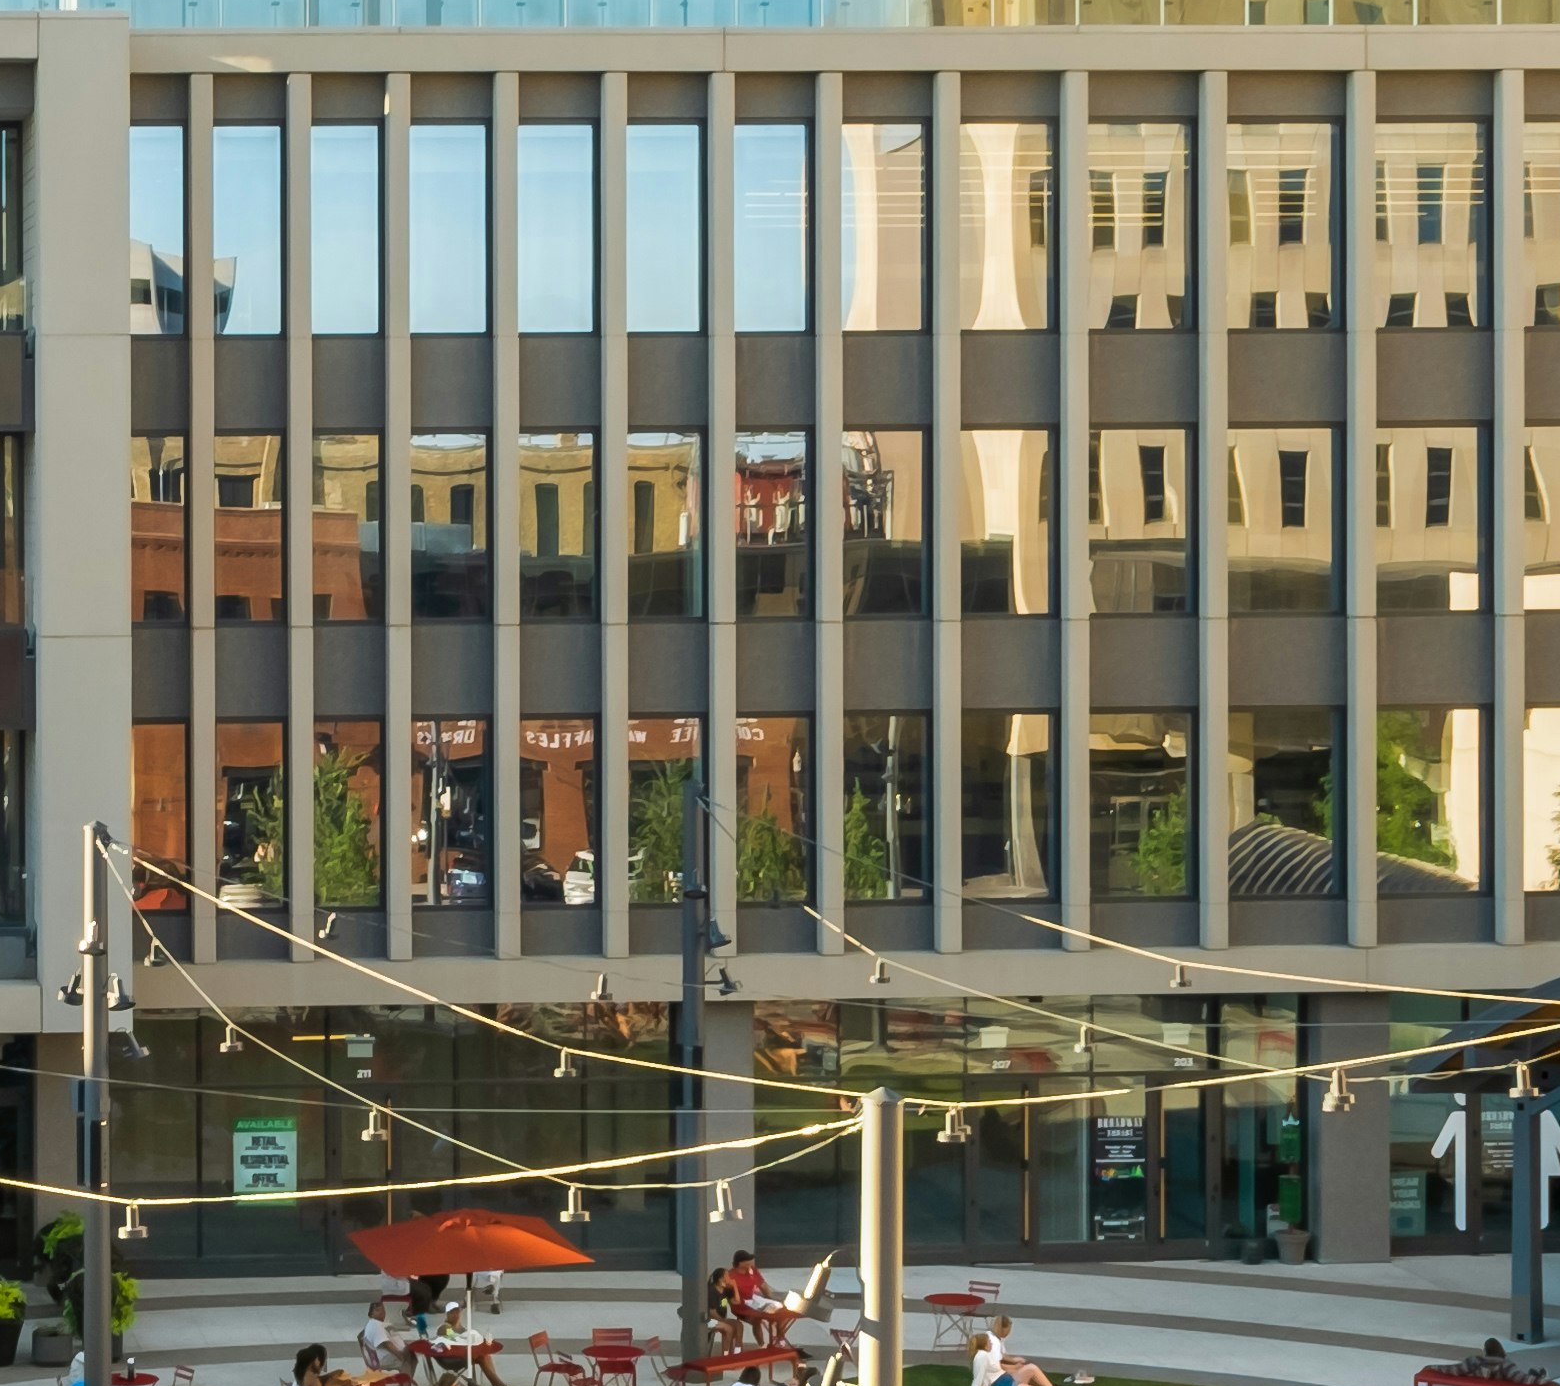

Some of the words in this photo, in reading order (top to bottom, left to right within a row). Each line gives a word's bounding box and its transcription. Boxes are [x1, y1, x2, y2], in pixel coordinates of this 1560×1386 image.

[992, 1060, 1011, 1070] 207
[1173, 1057, 1194, 1067] 203
[236, 1119, 294, 1129] AVAILABLE
